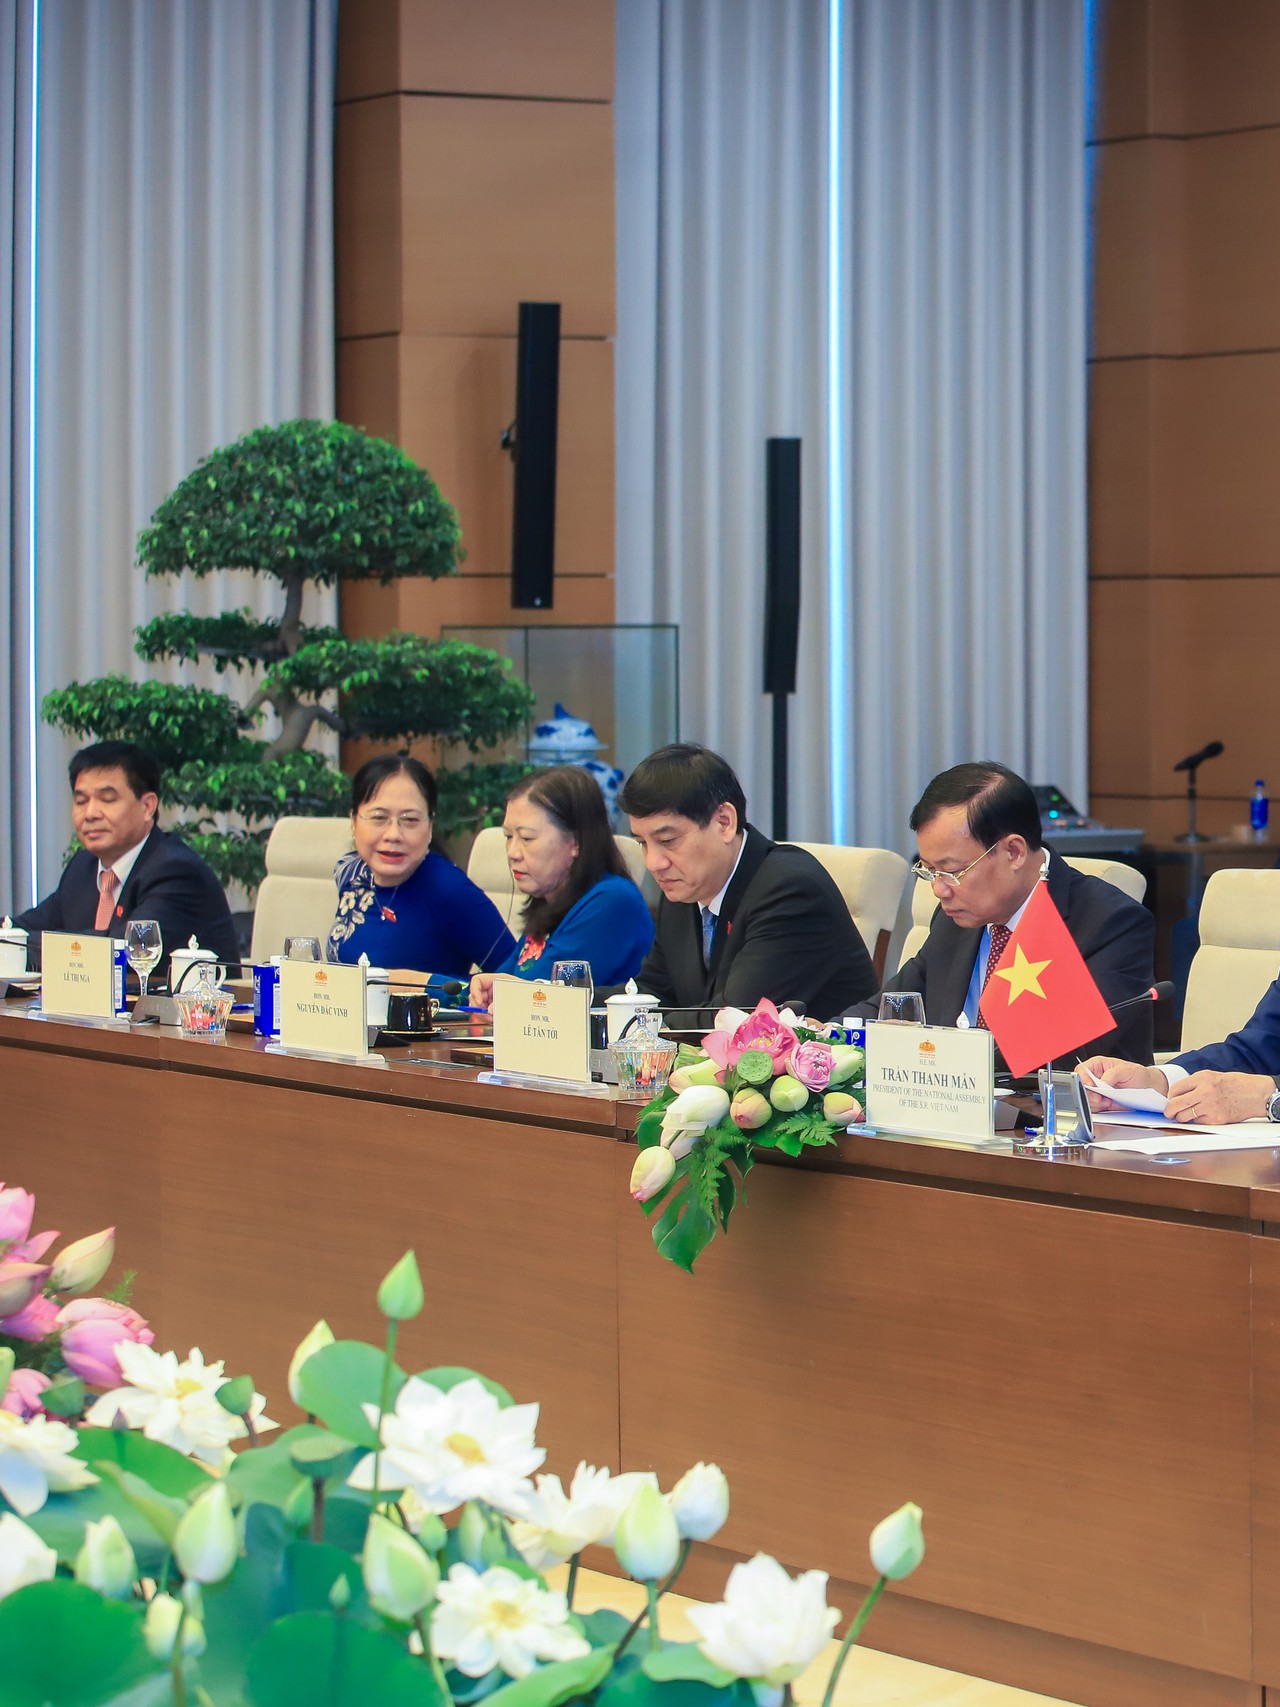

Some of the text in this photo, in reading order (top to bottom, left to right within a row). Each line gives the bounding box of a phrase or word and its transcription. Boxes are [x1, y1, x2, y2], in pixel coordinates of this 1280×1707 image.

[80, 974, 90, 983] NGA
[333, 1007, 348, 1017] VINH
[523, 1024, 531, 1036] LÊ
[881, 1065, 909, 1082] TRẦN
[912, 1070, 948, 1087] THANH
[872, 1083, 986, 1104] PRESIDENT OF THE NATIONAL ASSEMBLY
[898, 1098, 906, 1106] OF
[907, 1099, 918, 1108] THE
[930, 1101, 944, 1112] VIỆT
[944, 1103, 959, 1113] NAM
